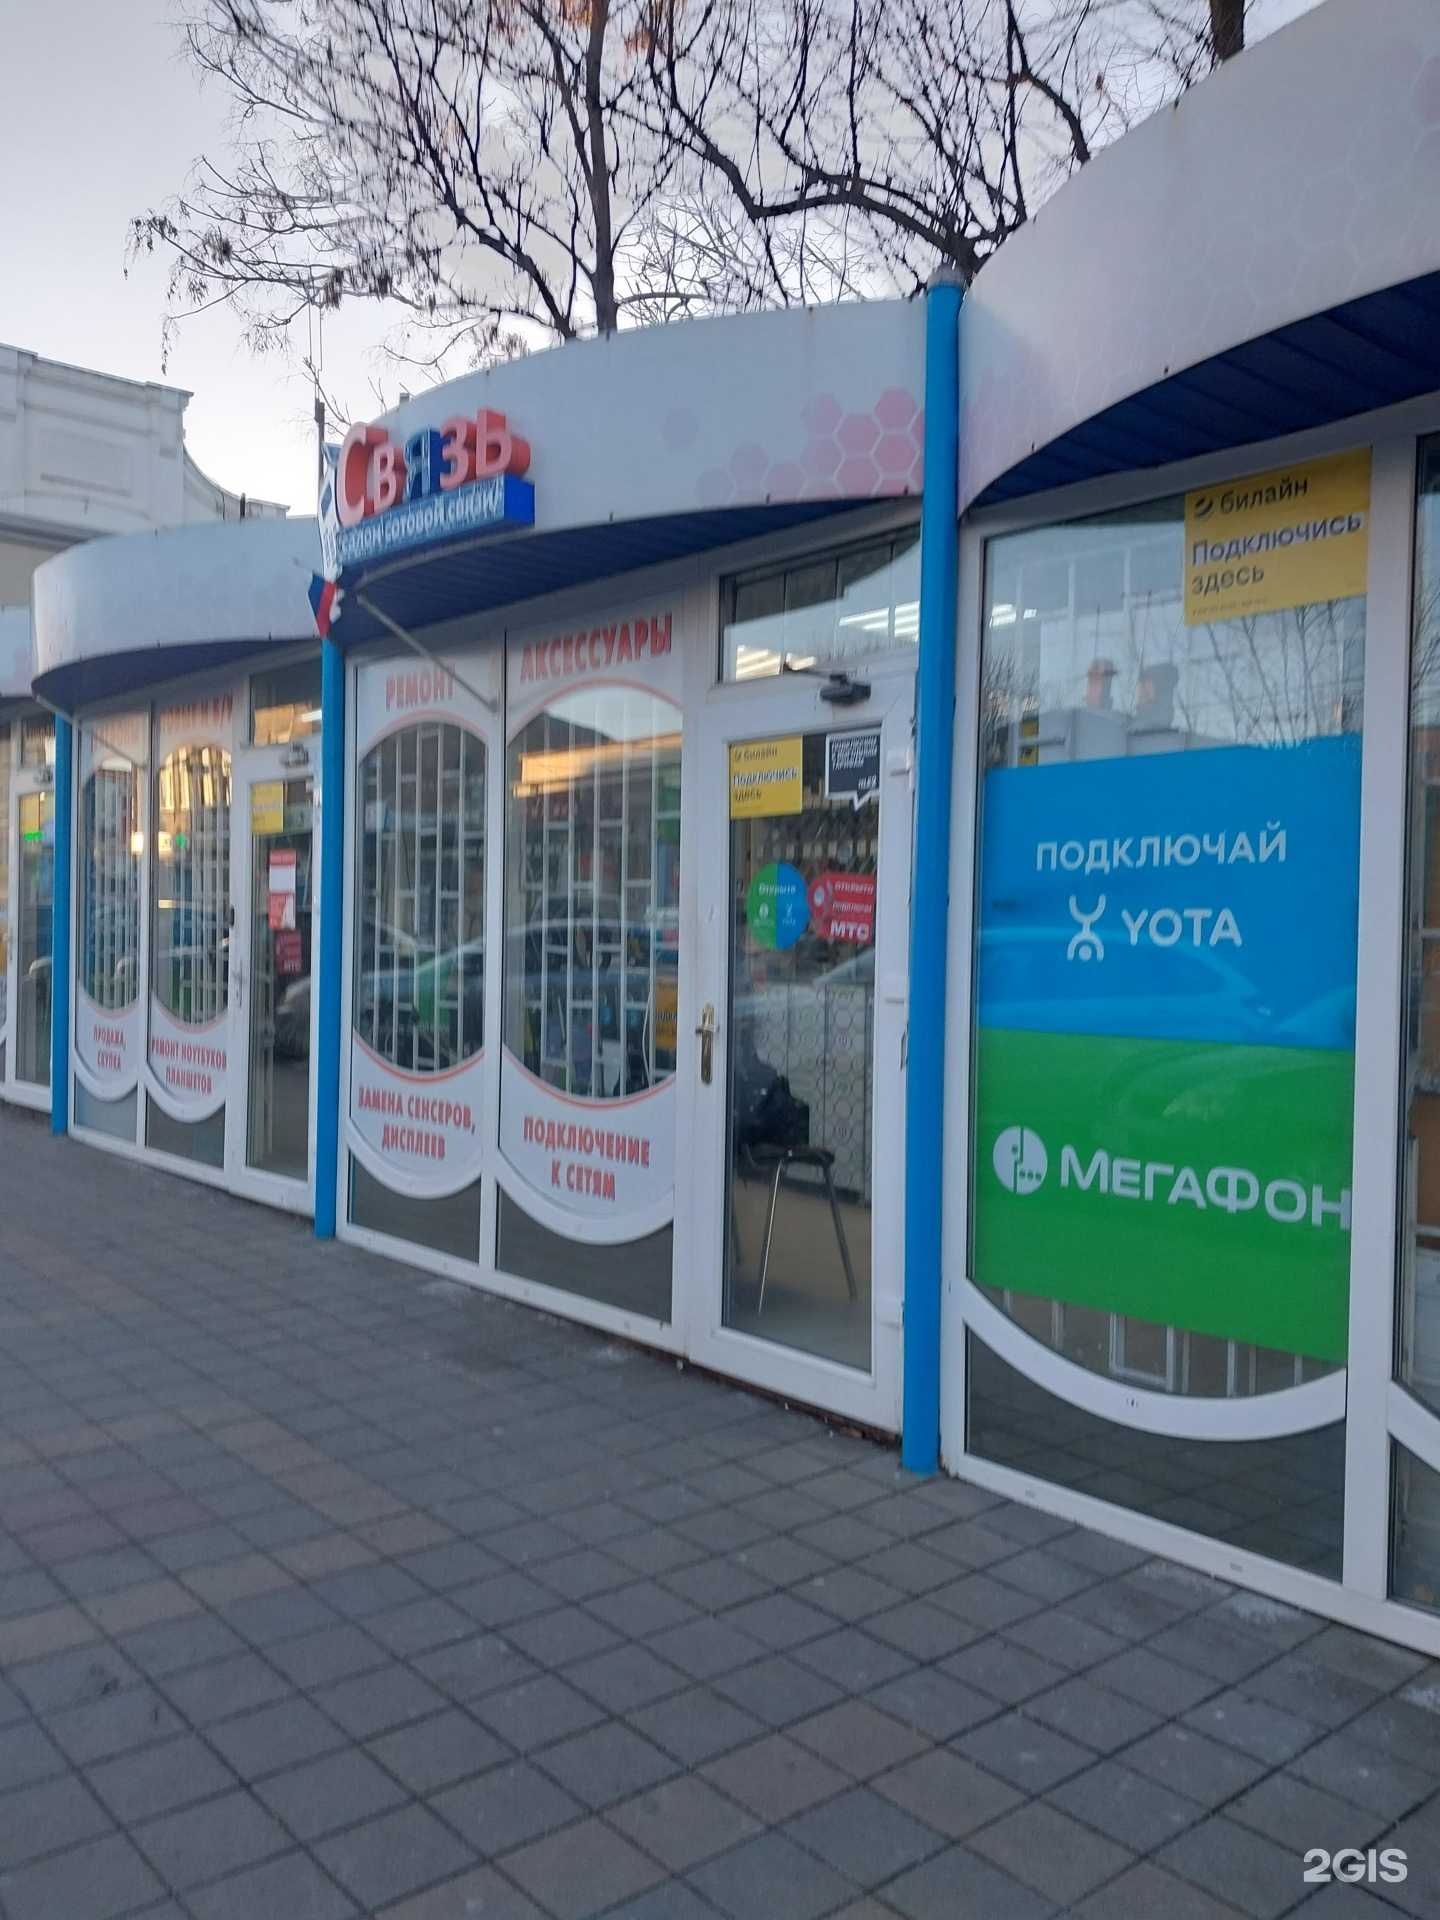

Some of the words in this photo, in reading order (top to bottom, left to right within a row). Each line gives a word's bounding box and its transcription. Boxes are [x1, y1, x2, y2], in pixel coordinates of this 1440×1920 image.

[1220, 476, 1308, 514] билайн
[1192, 511, 1363, 566] Подключись
[1191, 564, 1265, 597] здесь
[520, 612, 673, 684] АКСЕССУАРЫ
[385, 663, 456, 711] РЕМОНТ
[1035, 820, 1287, 875] ПОДКЛЮЧАЙ
[1121, 907, 1243, 948] YOTA
[358, 1085, 404, 1118] ЗАМЕНА
[381, 1122, 446, 1162] ДИСПЛЕЕВ
[523, 1115, 650, 1169] ПОДКЛЮЧЕНИЕ
[550, 1159, 562, 1189] К
[566, 1165, 617, 1202] СЕТЯМ
[1060, 1144, 1352, 1231] МЕГАФОН
